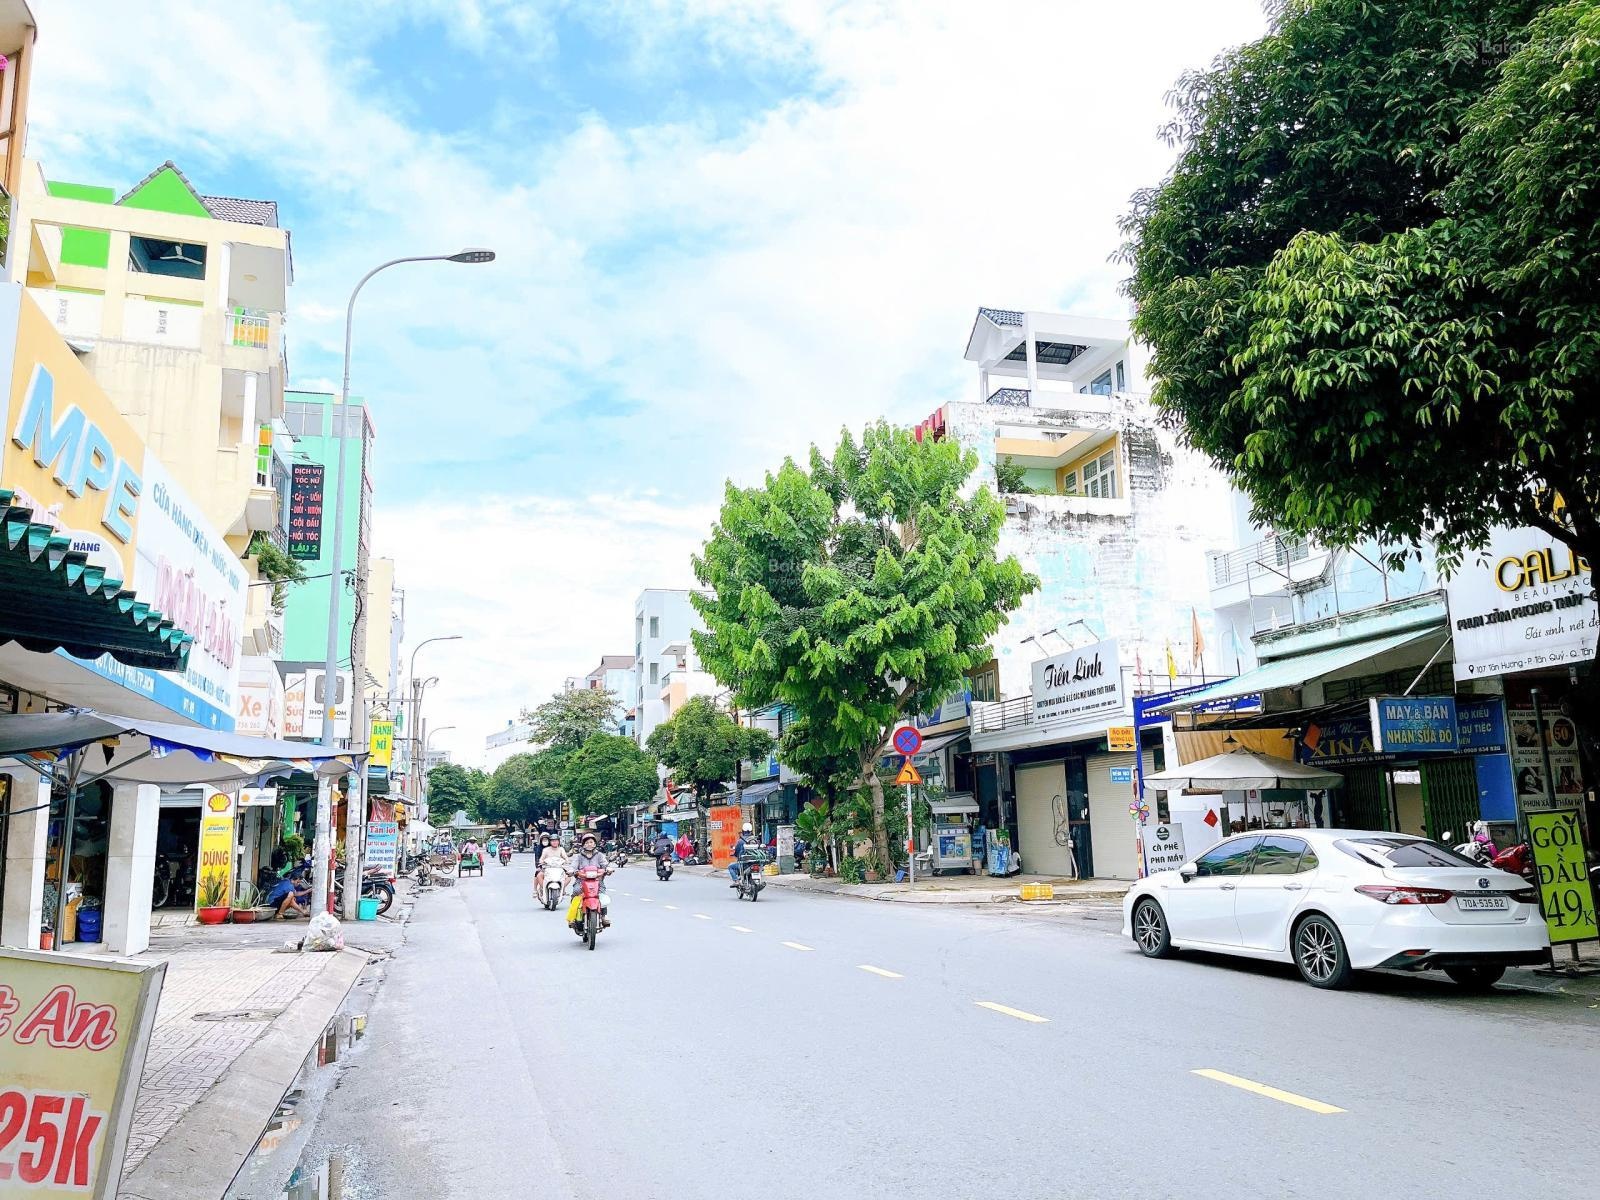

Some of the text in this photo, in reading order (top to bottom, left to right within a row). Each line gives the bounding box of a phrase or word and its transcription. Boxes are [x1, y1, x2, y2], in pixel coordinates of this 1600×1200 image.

[12, 362, 144, 545] MPE
[1511, 600, 1553, 620] PHONG
[1544, 616, 1565, 636] sinh
[1044, 652, 1104, 690] Tiến Linh
[240, 694, 262, 718] Xe
[1386, 702, 1449, 720] MAY & BÁN
[1532, 820, 1579, 853] GỘI
[1151, 856, 1166, 864] PHA
[1538, 853, 1587, 885] ĐẦU
[14, 985, 117, 1051] An
